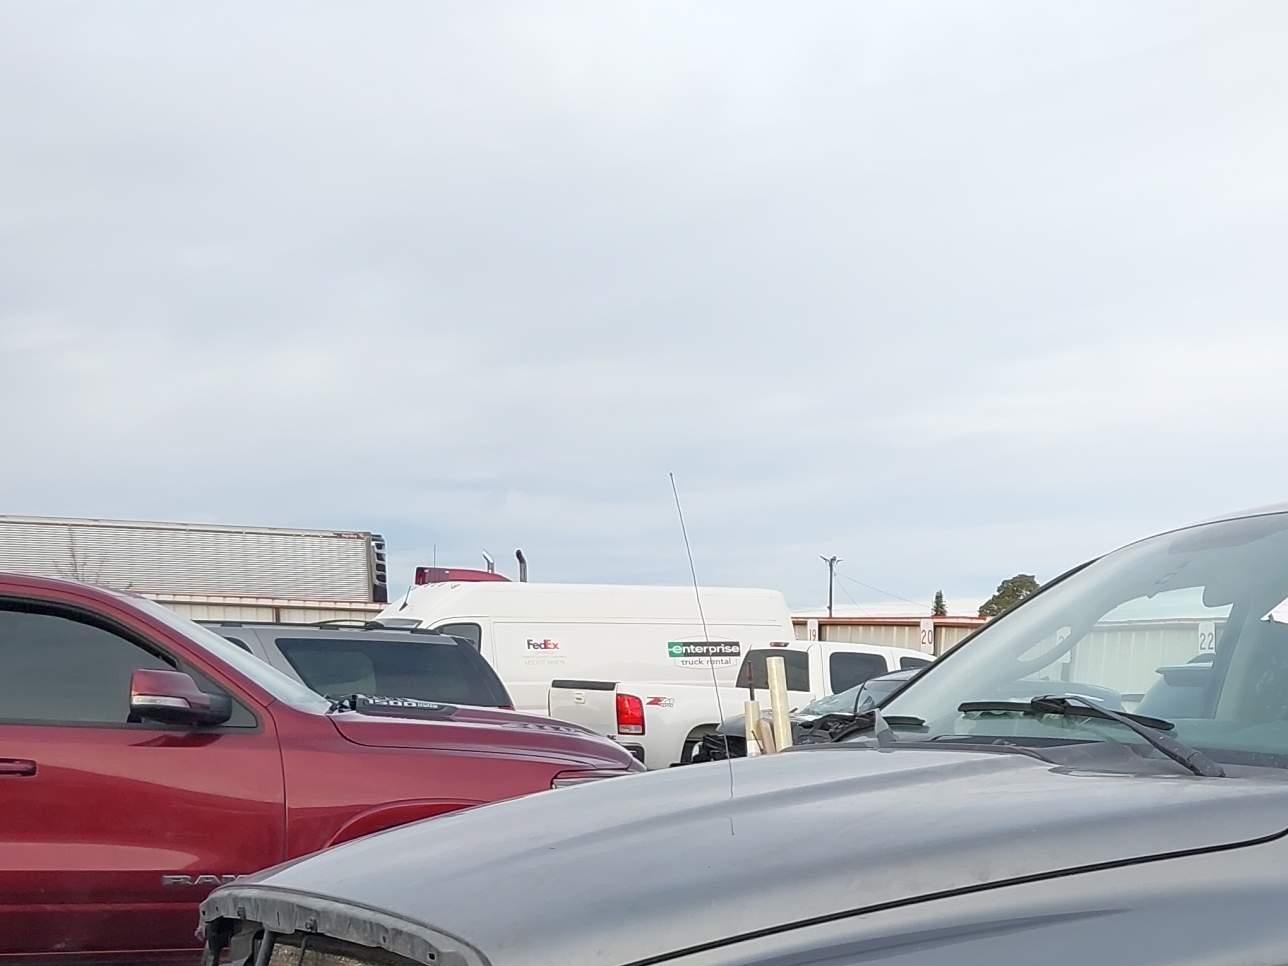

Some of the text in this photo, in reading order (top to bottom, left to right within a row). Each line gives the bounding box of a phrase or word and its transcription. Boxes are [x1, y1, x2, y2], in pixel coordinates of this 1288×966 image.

[809, 628, 817, 641] 19
[921, 629, 933, 645] 20
[527, 639, 560, 650] FedEx
[1199, 632, 1214, 651] 22
[668, 643, 740, 656] enterprise
[681, 658, 704, 666] truck
